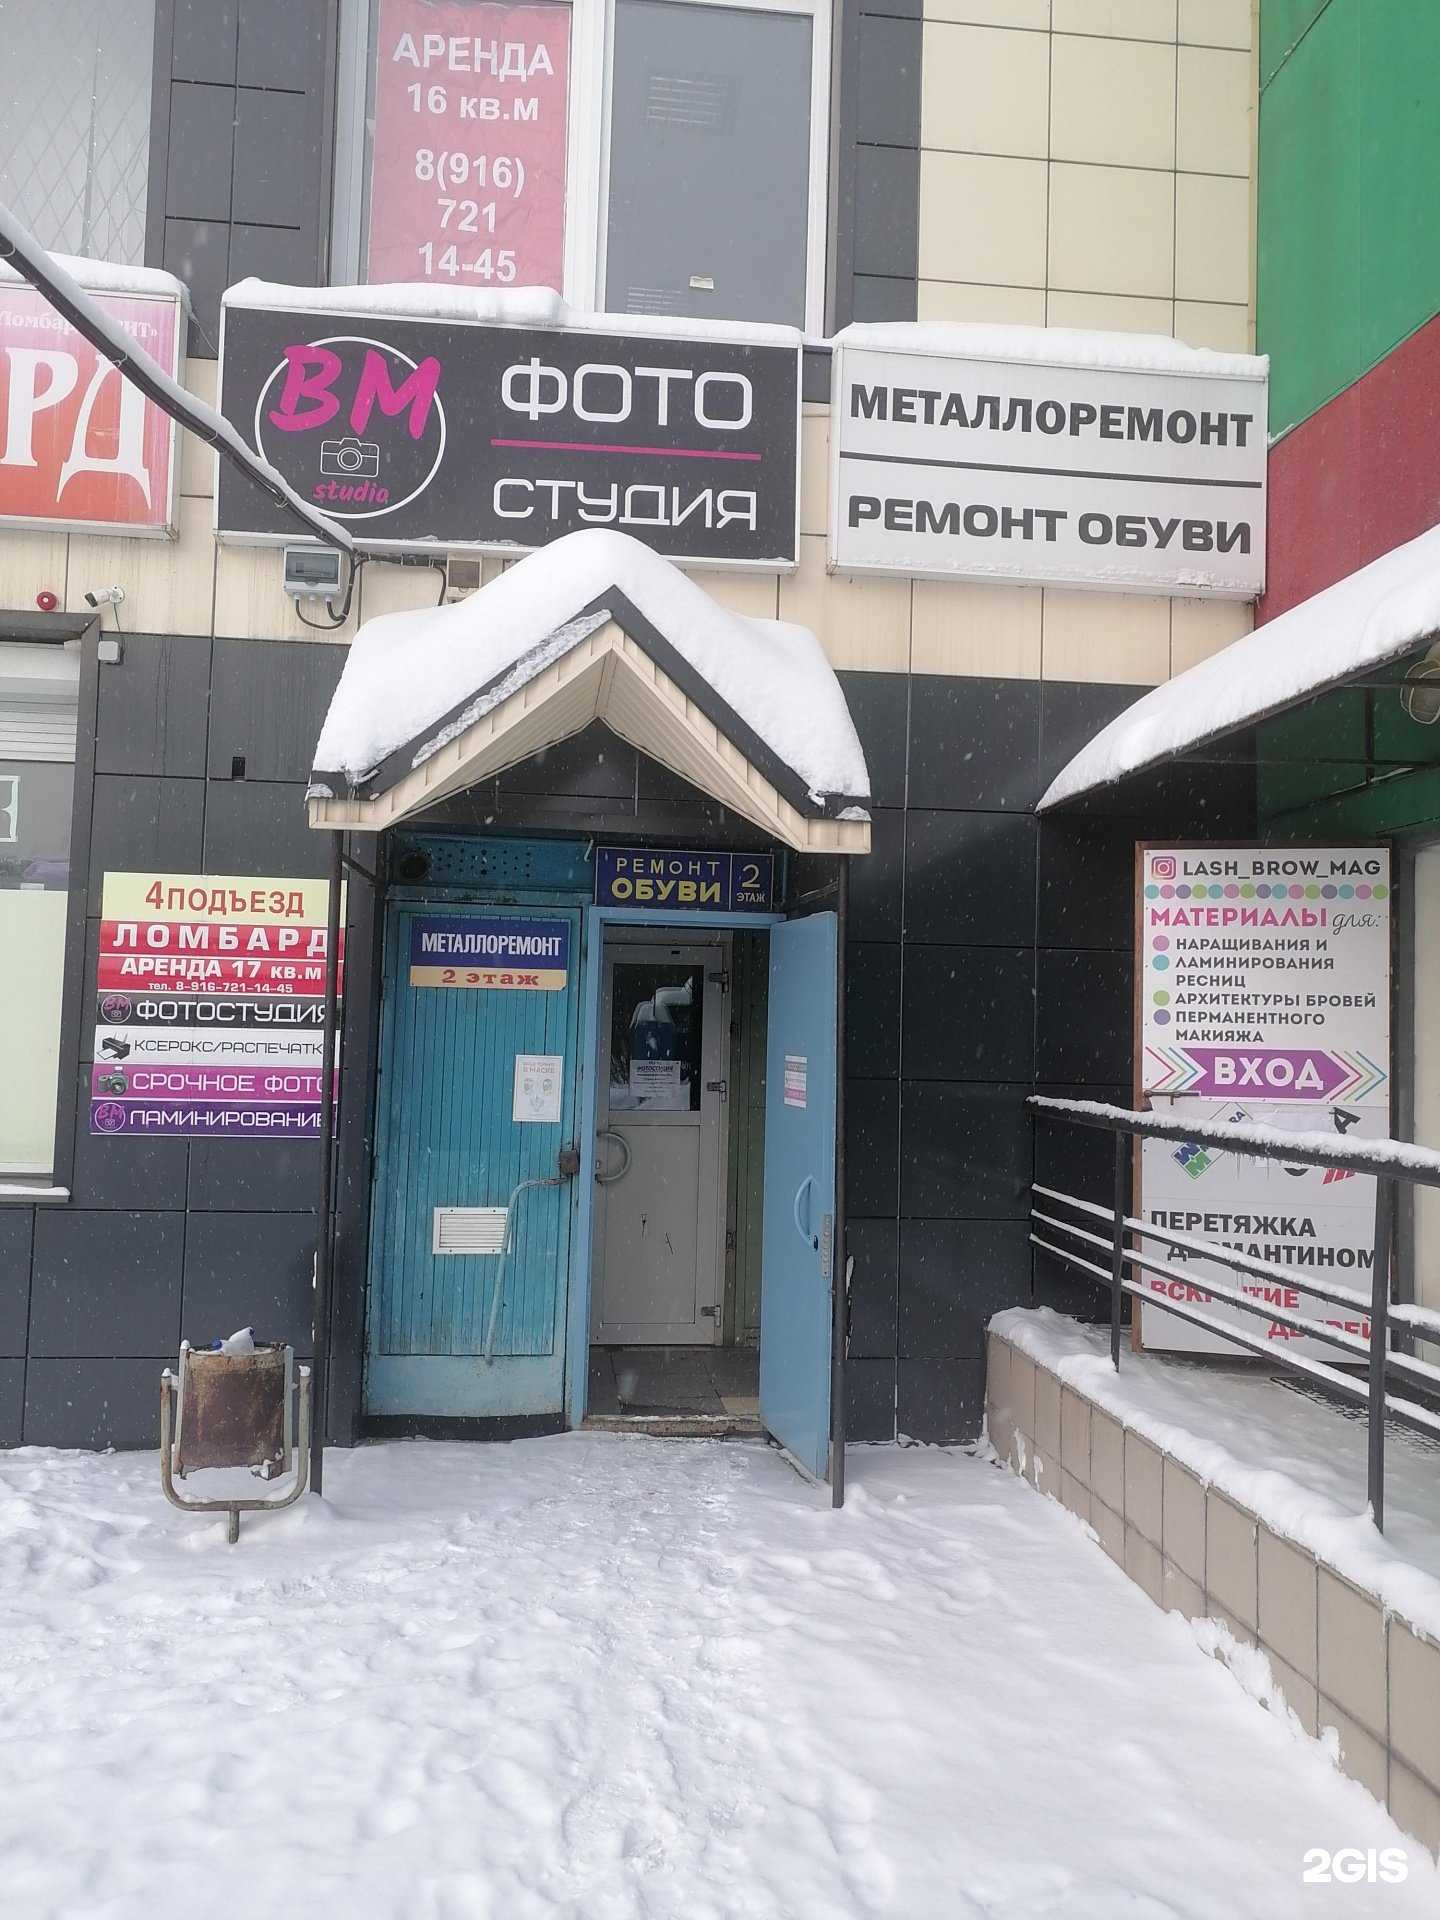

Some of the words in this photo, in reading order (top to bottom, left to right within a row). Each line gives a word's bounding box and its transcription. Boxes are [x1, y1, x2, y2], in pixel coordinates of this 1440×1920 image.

[392, 32, 554, 82] АРЕНДА
[407, 83, 447, 114] 16
[460, 96, 538, 121] кв.м
[415, 149, 525, 198] 8(916)
[438, 199, 496, 233] 721
[419, 242, 516, 282] 14-45
[269, 345, 441, 440] BM
[501, 357, 753, 430] ФОТО
[850, 384, 1253, 447] МЕТАЛЛОРЕМОНТ
[493, 478, 757, 531] СТУДИЯ
[848, 495, 1067, 542] РЕМОНТ
[1078, 512, 1251, 554] ОБУВИ
[616, 857, 721, 877] РЕМОНТ
[742, 864, 761, 888] 2
[1183, 860, 1381, 880] LASH_BROW_MAG
[611, 877, 721, 903] ОБУВИ
[736, 892, 765, 903] ЭТАЖ
[1151, 907, 1327, 928] МАТЕРИАЛЫ
[1332, 913, 1380, 935] для:
[422, 933, 561, 956] МЕТАЛЛОРЕМОНТ
[1176, 938, 1310, 952] НАРАЩИВАНИЯ
[1316, 939, 1328, 951] И
[120, 957, 222, 981] АРЕНДА
[232, 961, 261, 978] 17
[271, 966, 321, 980] кв.м
[1175, 957, 1335, 970] ЛАМИНИРОВАНИЯ
[148, 982, 171, 991] тел.
[176, 981, 293, 994] 8-916-721-14-45
[442, 969, 456, 983] 2
[466, 973, 539, 986] этаж
[1176, 975, 1247, 989] РЕСНИЦ
[1175, 993, 1300, 1007] АРХИТЕКТУРЫ
[1306, 993, 1377, 1008] БРОВЕЙ
[1175, 1011, 1326, 1026] ПЕРМАНЕНТНОГО
[1176, 1029, 1265, 1043] МАКИЯЖА
[132, 1073, 255, 1093] СРОЧНОЕ
[1214, 1056, 1324, 1091] ВХОД
[1151, 1210, 1317, 1237] ПЕРЕТЯЖКА
